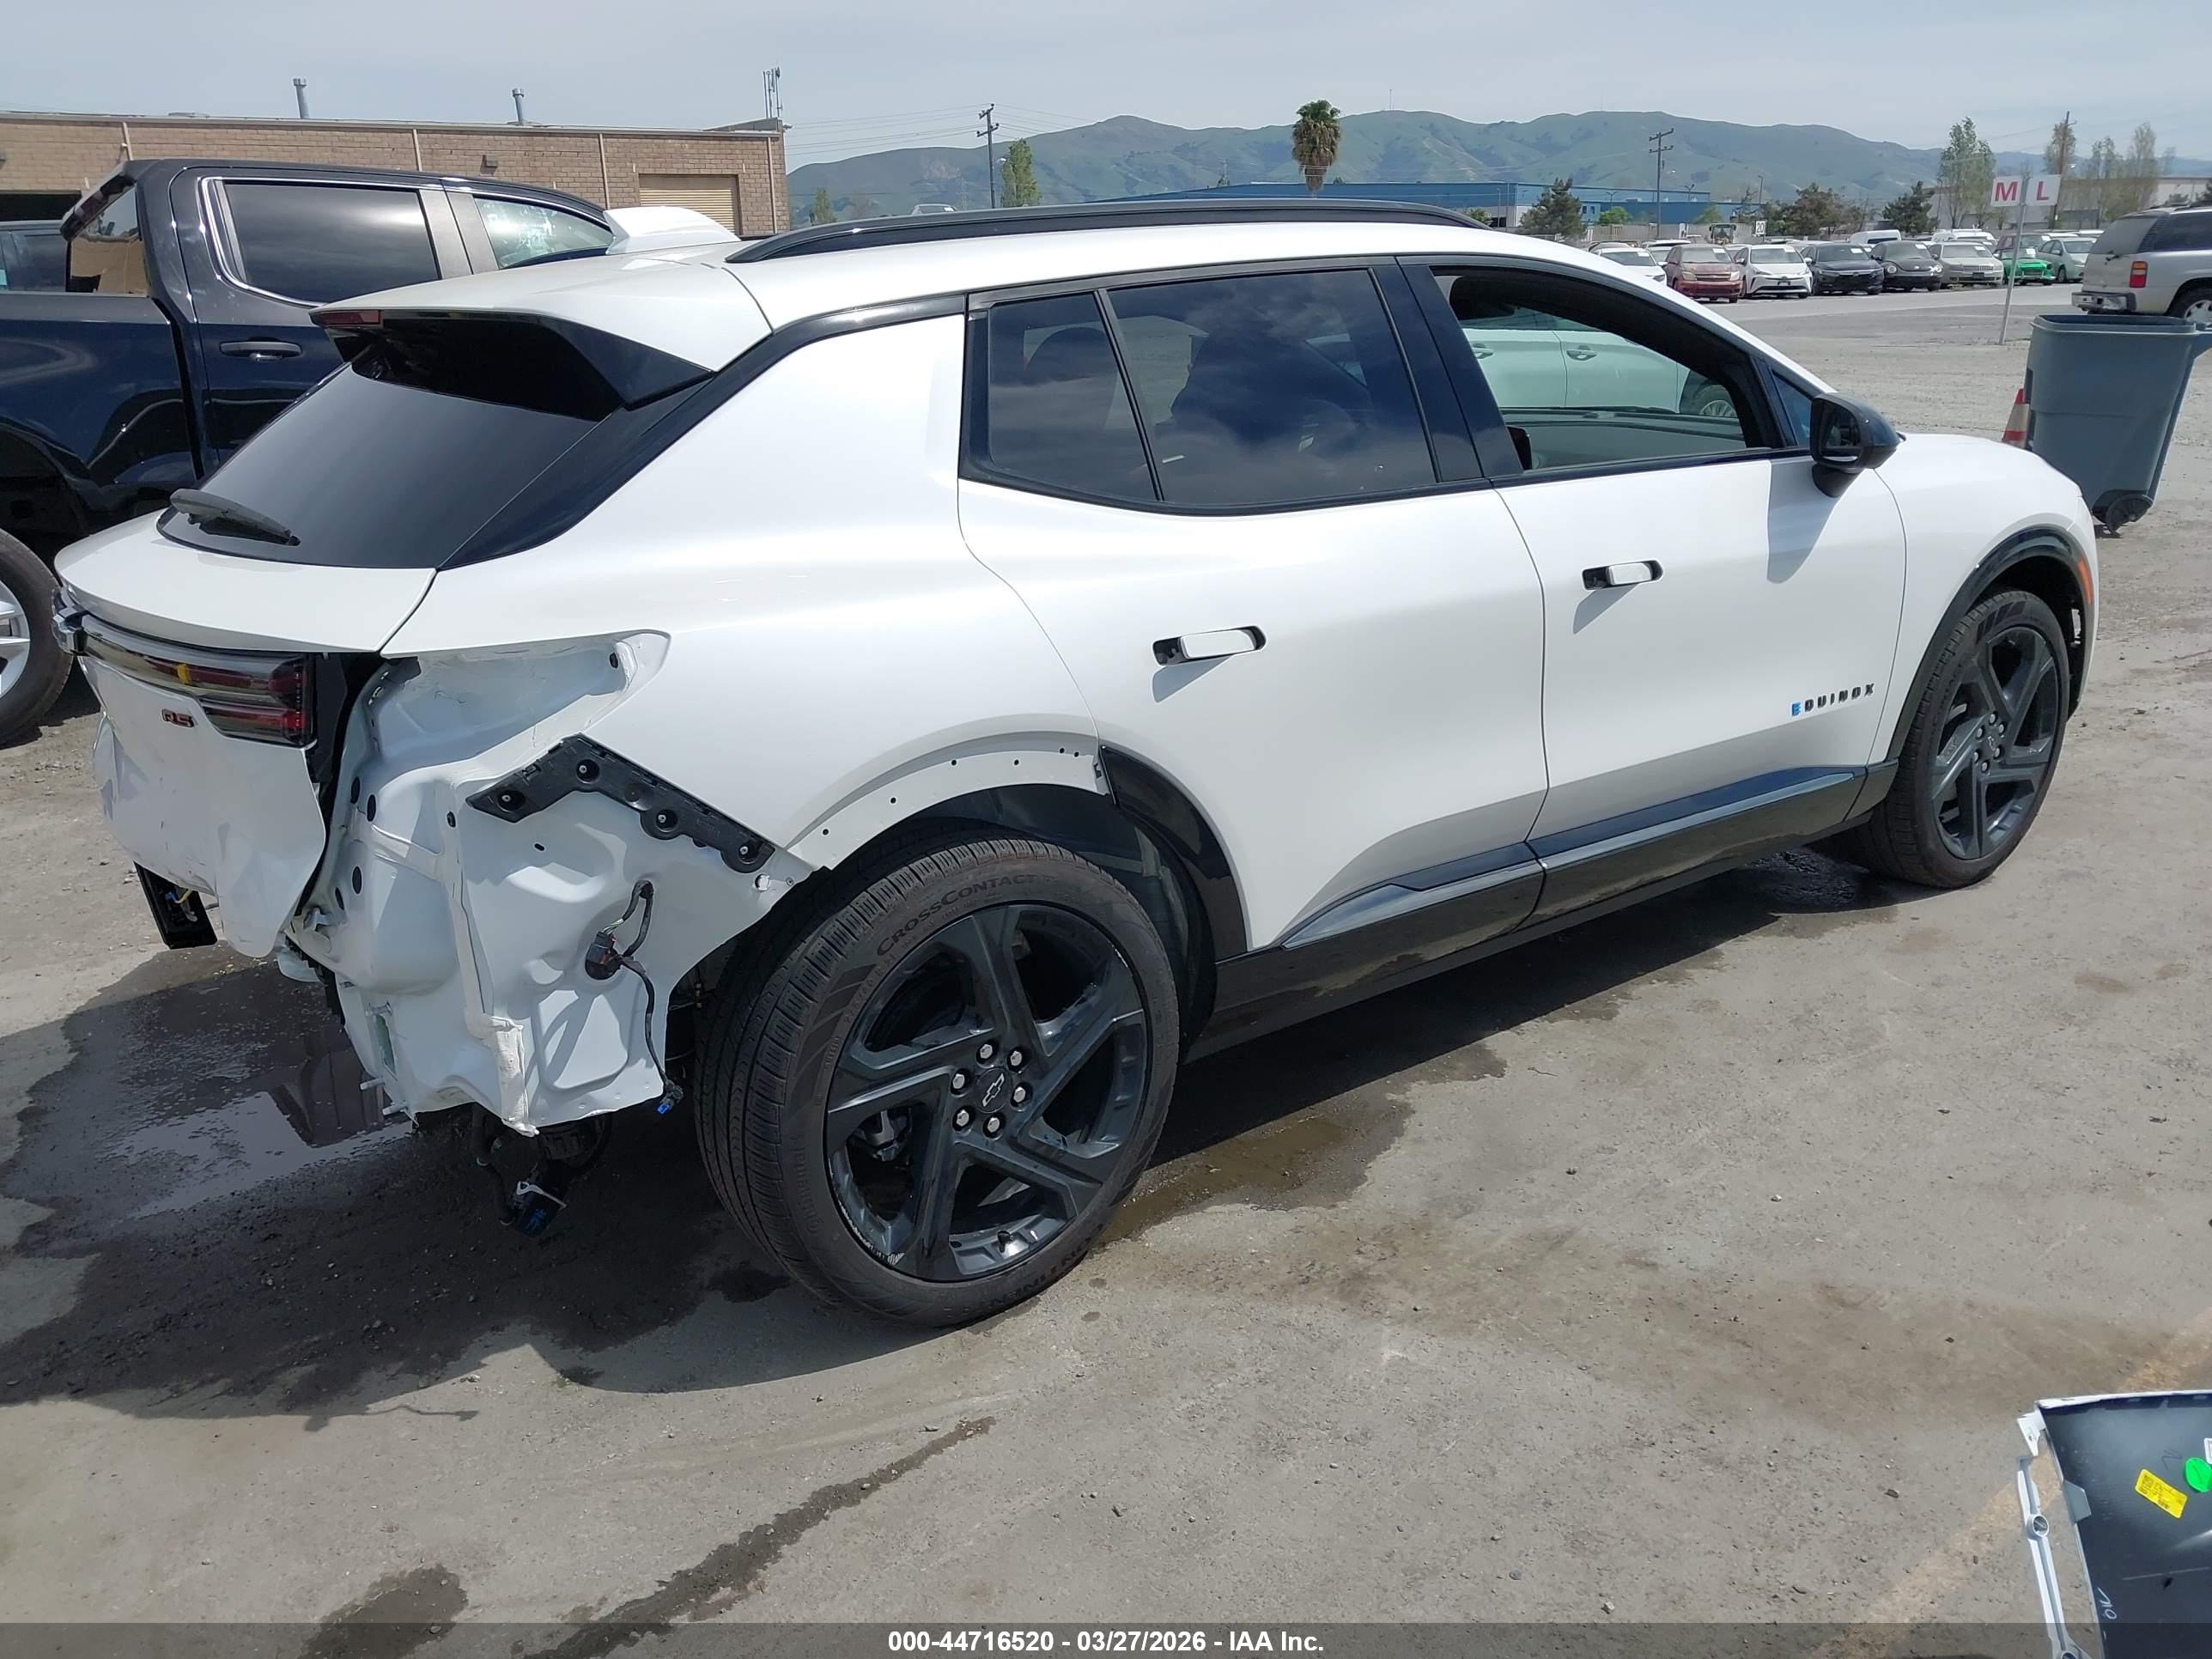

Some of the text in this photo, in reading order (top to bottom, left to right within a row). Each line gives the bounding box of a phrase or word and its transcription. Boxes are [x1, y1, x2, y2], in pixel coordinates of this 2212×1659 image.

[1995, 181, 2018, 202] M
[2036, 180, 2050, 201] L
[1756, 222, 1765, 234] 20
[1791, 683, 1875, 716] EQUINOX
[161, 708, 195, 728] RS
